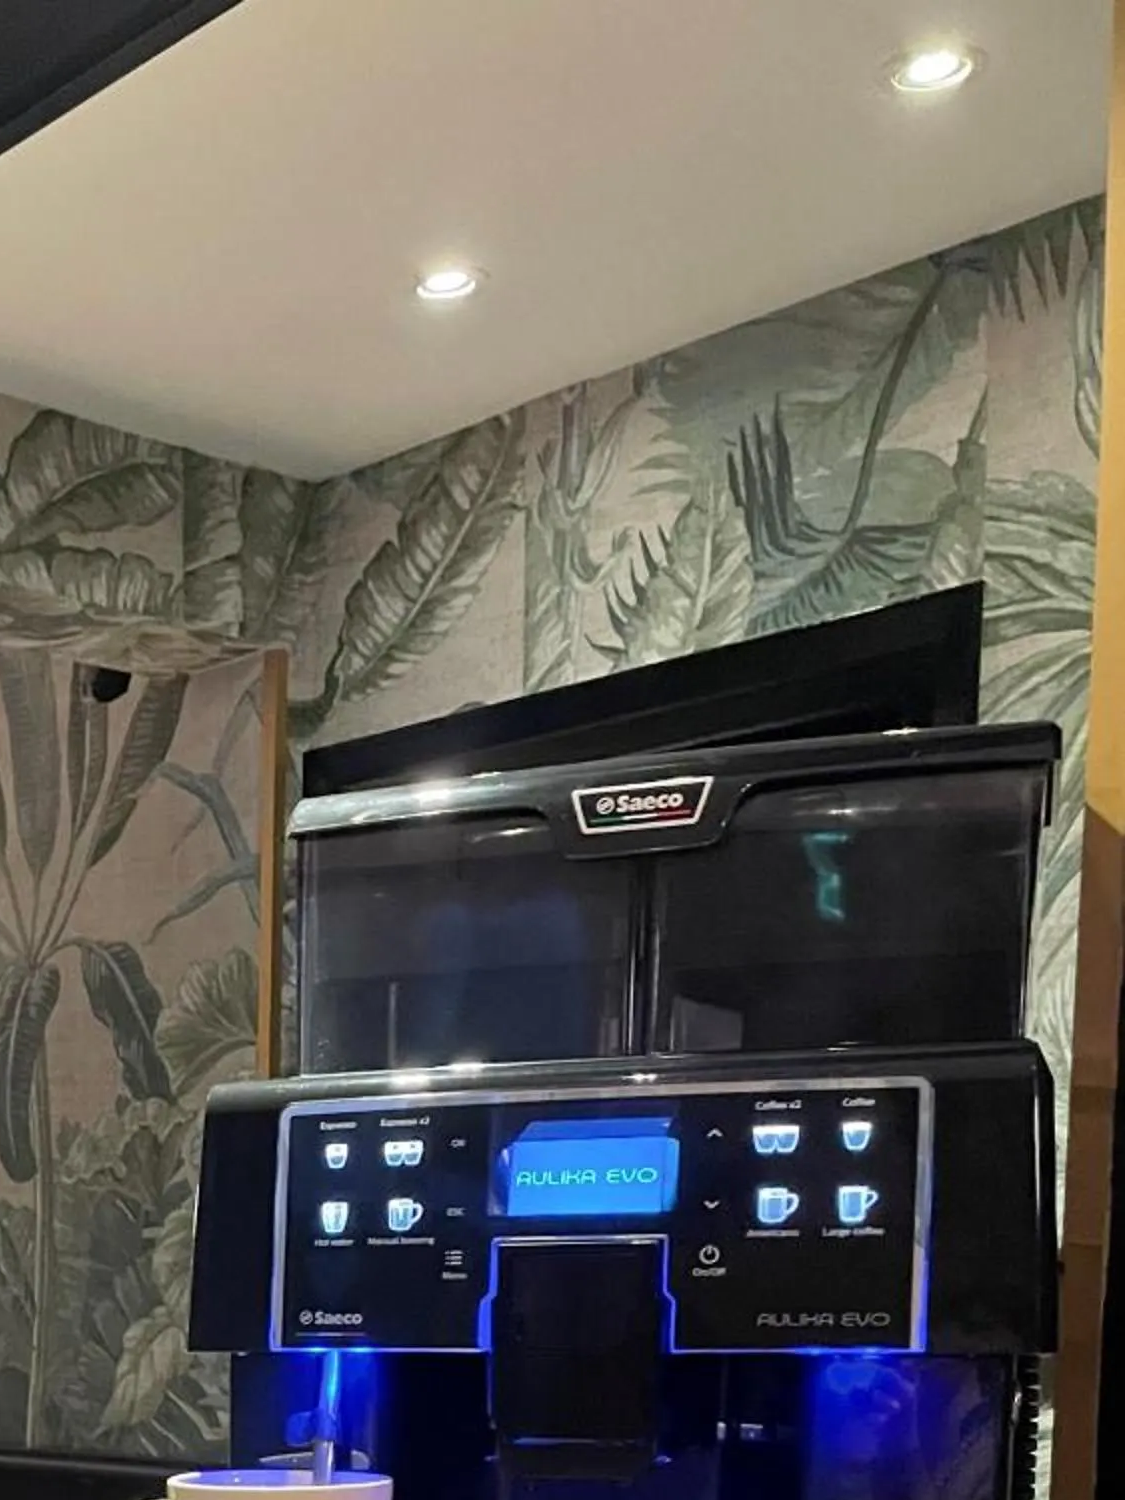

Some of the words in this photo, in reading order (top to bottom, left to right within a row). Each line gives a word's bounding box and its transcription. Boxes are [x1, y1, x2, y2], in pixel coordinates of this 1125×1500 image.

[616, 792, 684, 813] Saeco
[516, 1168, 596, 1186] AULIKA
[606, 1166, 658, 1184] EVO
[314, 1310, 364, 1326] Saeco
[757, 1312, 834, 1327] AULIKA
[841, 1311, 891, 1327] EVO
